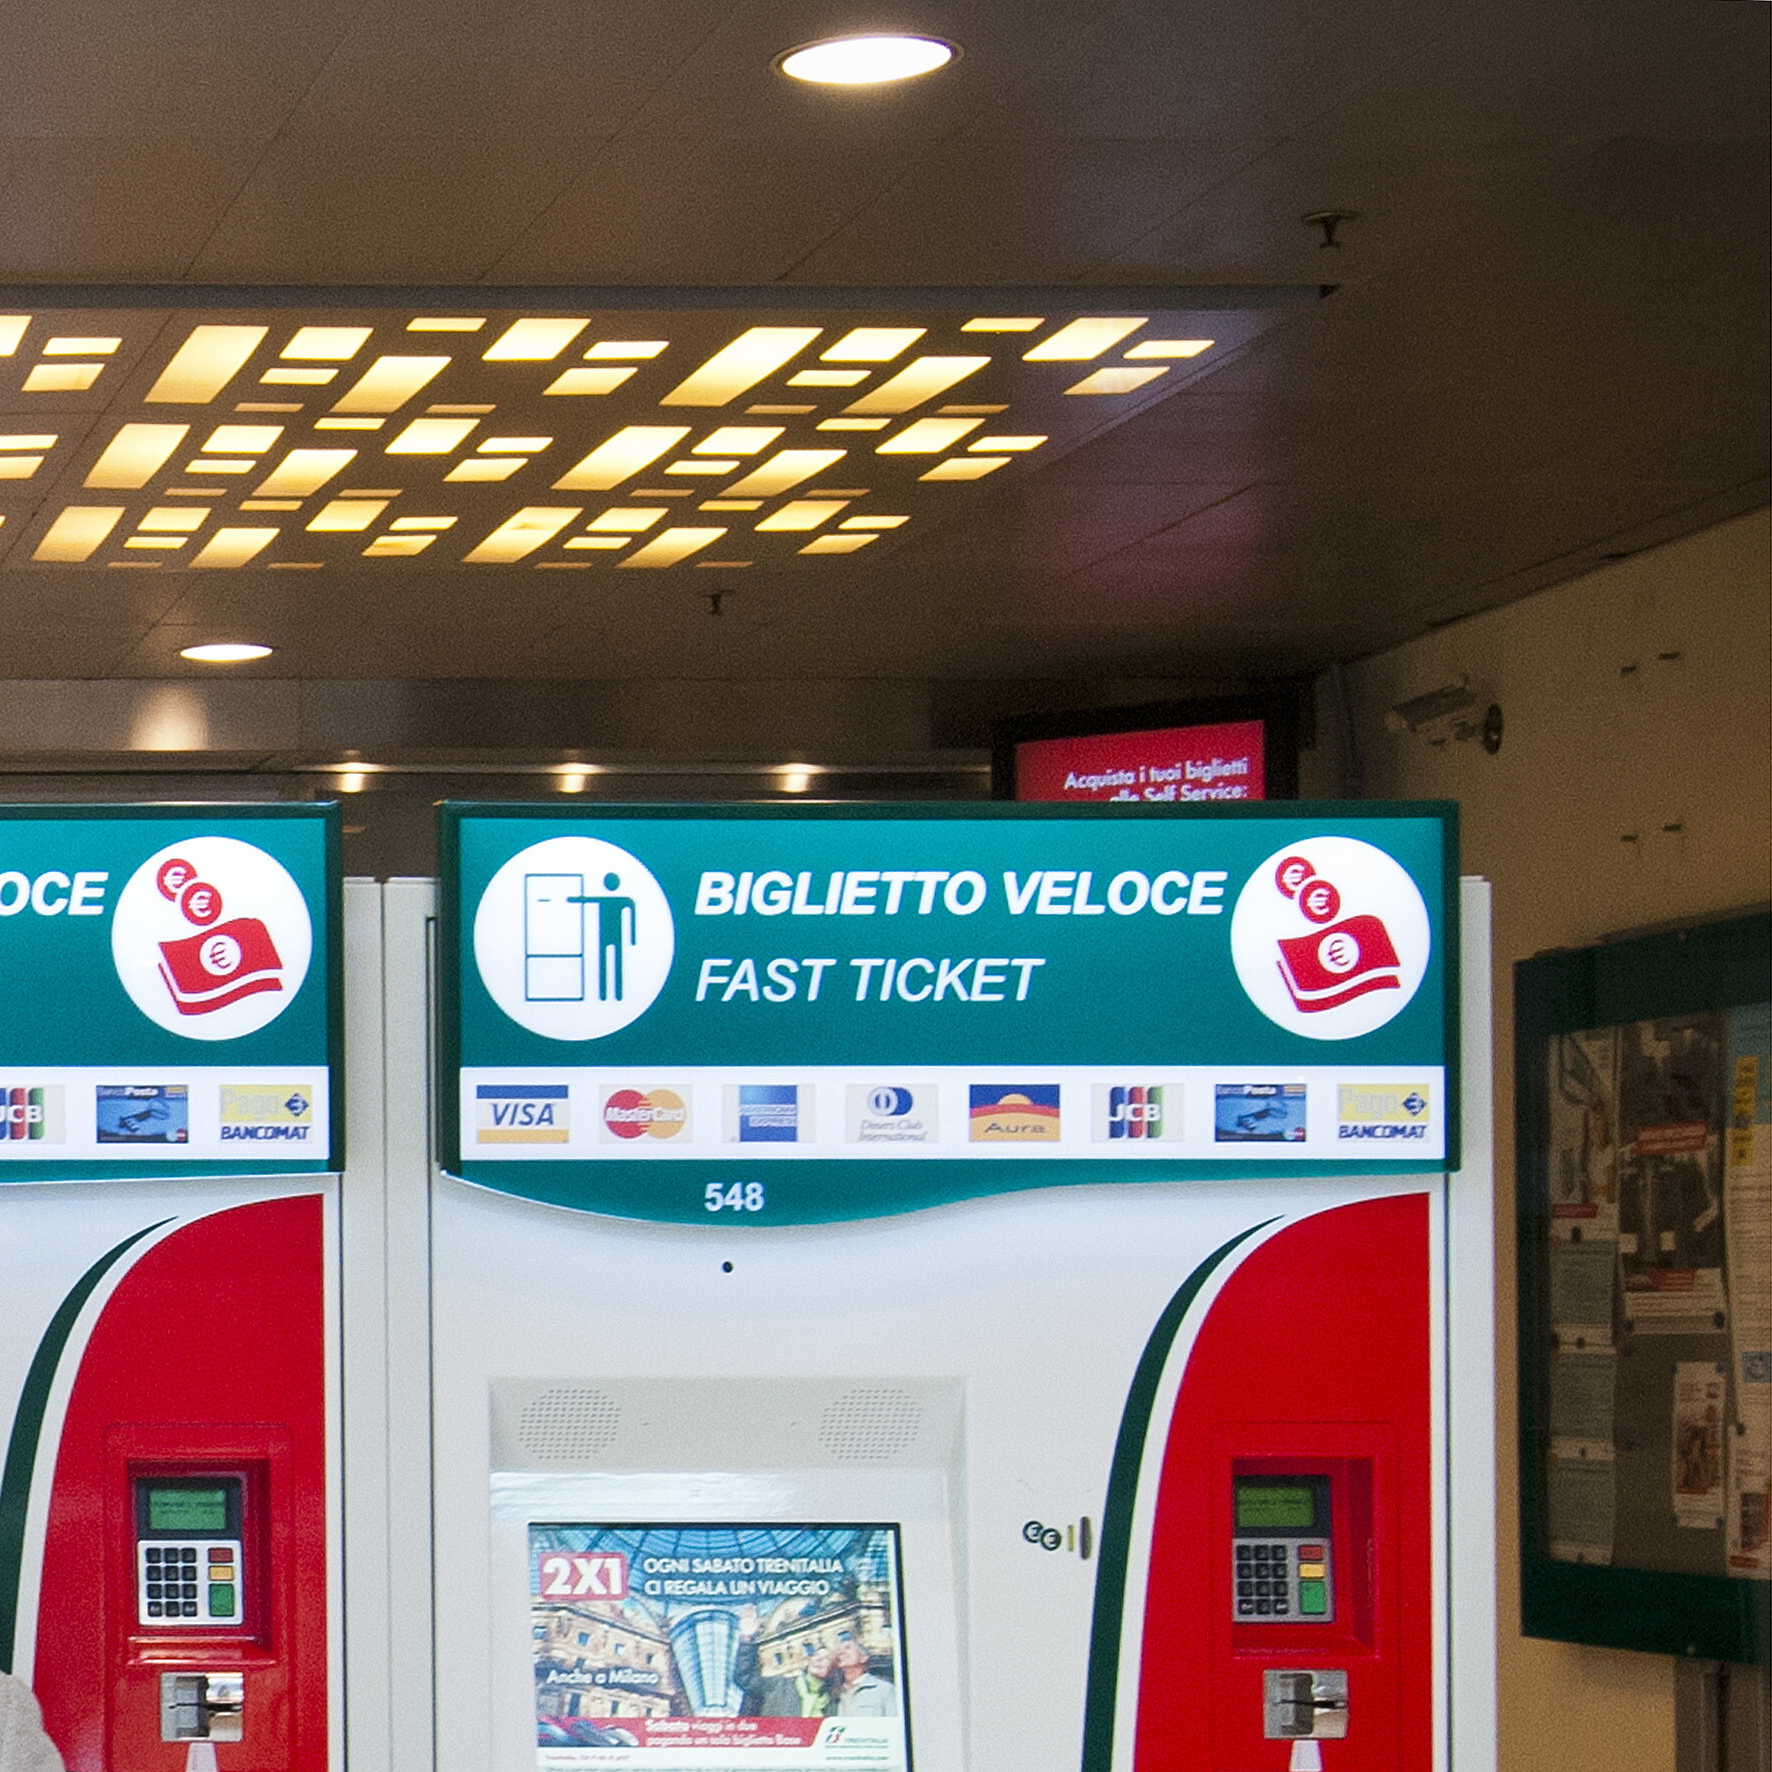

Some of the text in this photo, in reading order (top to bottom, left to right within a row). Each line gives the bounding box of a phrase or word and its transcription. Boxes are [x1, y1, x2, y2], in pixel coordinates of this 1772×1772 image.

[1063, 756, 1249, 791] Acquista i tuoi biglietti
[1144, 784, 1178, 802] Self
[695, 870, 1228, 916] BIGLIETTO VELOCE
[696, 958, 1046, 1002] FAST TICKET
[491, 1103, 555, 1126] VISA
[605, 1106, 685, 1122] MasterCard
[1108, 1104, 1162, 1122] JCB
[220, 1126, 311, 1140] BANCOMAT
[860, 1120, 923, 1131] Diners Club
[984, 1122, 1045, 1134] Aura
[1338, 1125, 1427, 1139] BANCOMAT
[705, 1183, 764, 1211] 548
[643, 1558, 844, 1574] OGNI SABATO TRENITALIA
[542, 1557, 623, 1596] 2X1
[644, 1579, 830, 1595] CI REGALA UN VIAGGIO
[546, 1669, 592, 1685] Anche
[609, 1668, 659, 1685] Milano
